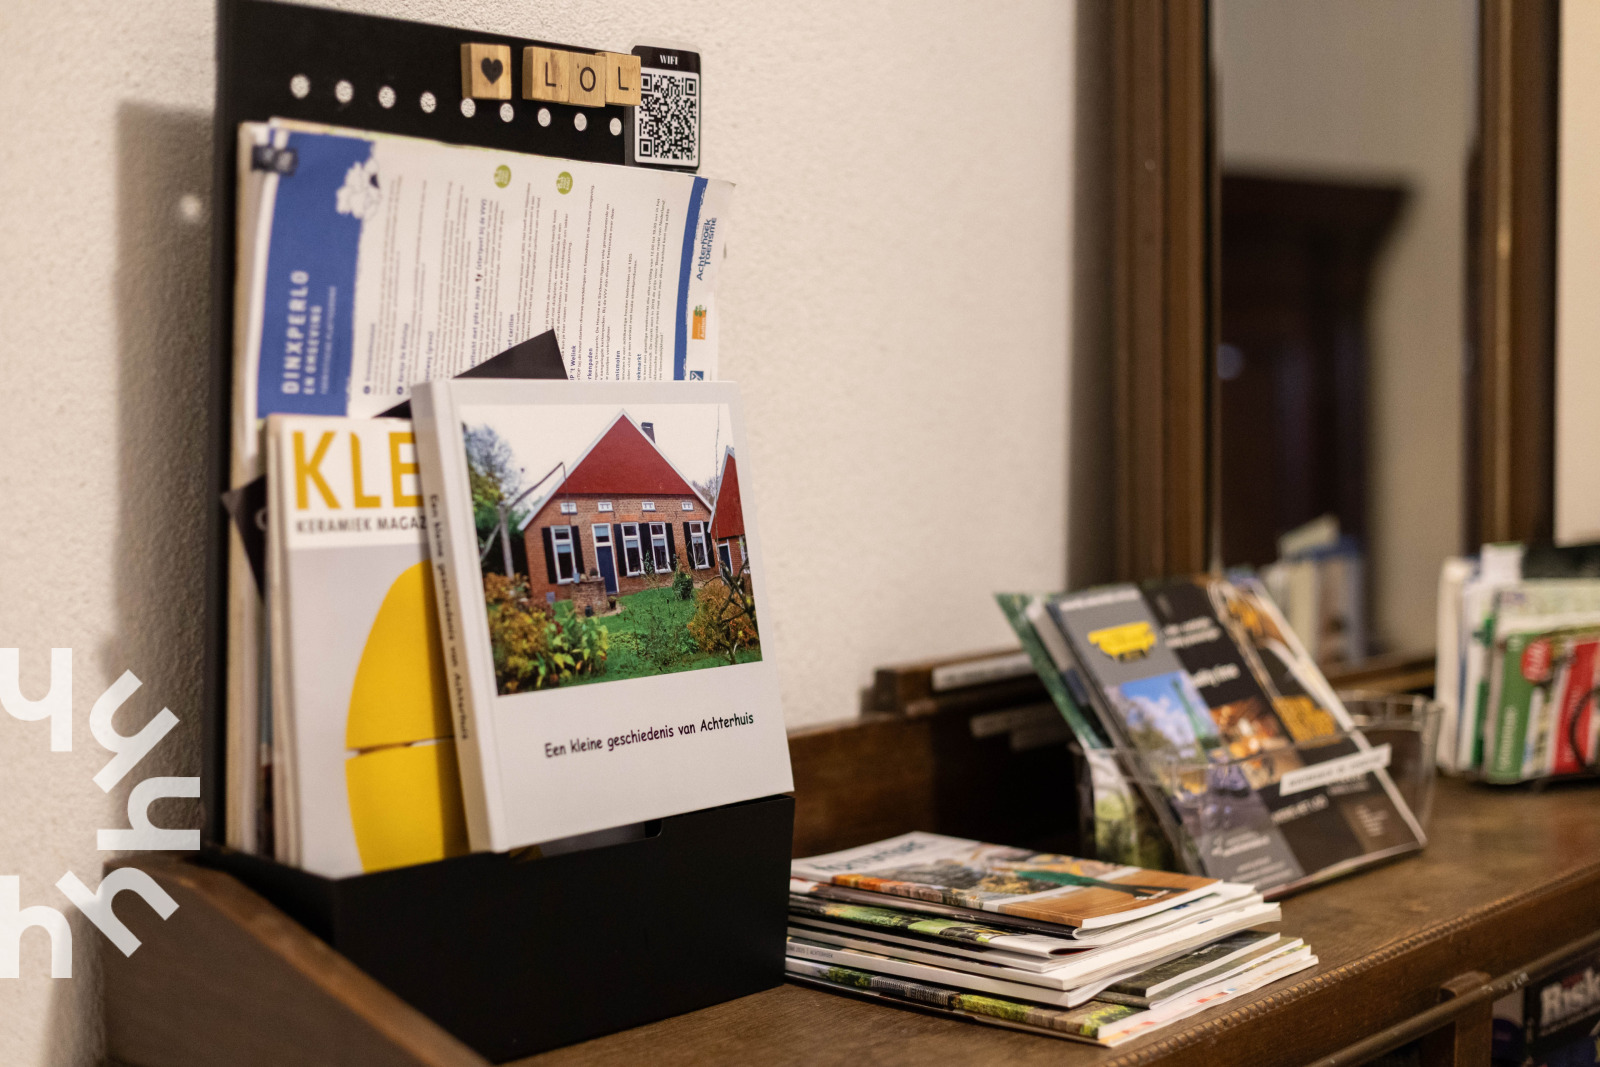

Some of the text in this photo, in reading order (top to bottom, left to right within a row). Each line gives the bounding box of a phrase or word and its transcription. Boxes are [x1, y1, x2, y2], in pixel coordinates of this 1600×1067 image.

[545, 62, 629, 92] LOL
[659, 54, 678, 65] WIFI
[696, 219, 711, 280] Achterhoek
[282, 270, 309, 394] DINXPERLO
[304, 306, 322, 394] EN OMGEVING
[291, 430, 424, 510] KLE
[295, 516, 372, 533] KERAMIEK
[544, 712, 754, 758] Een kleine geschiedenis van Achterhuis
